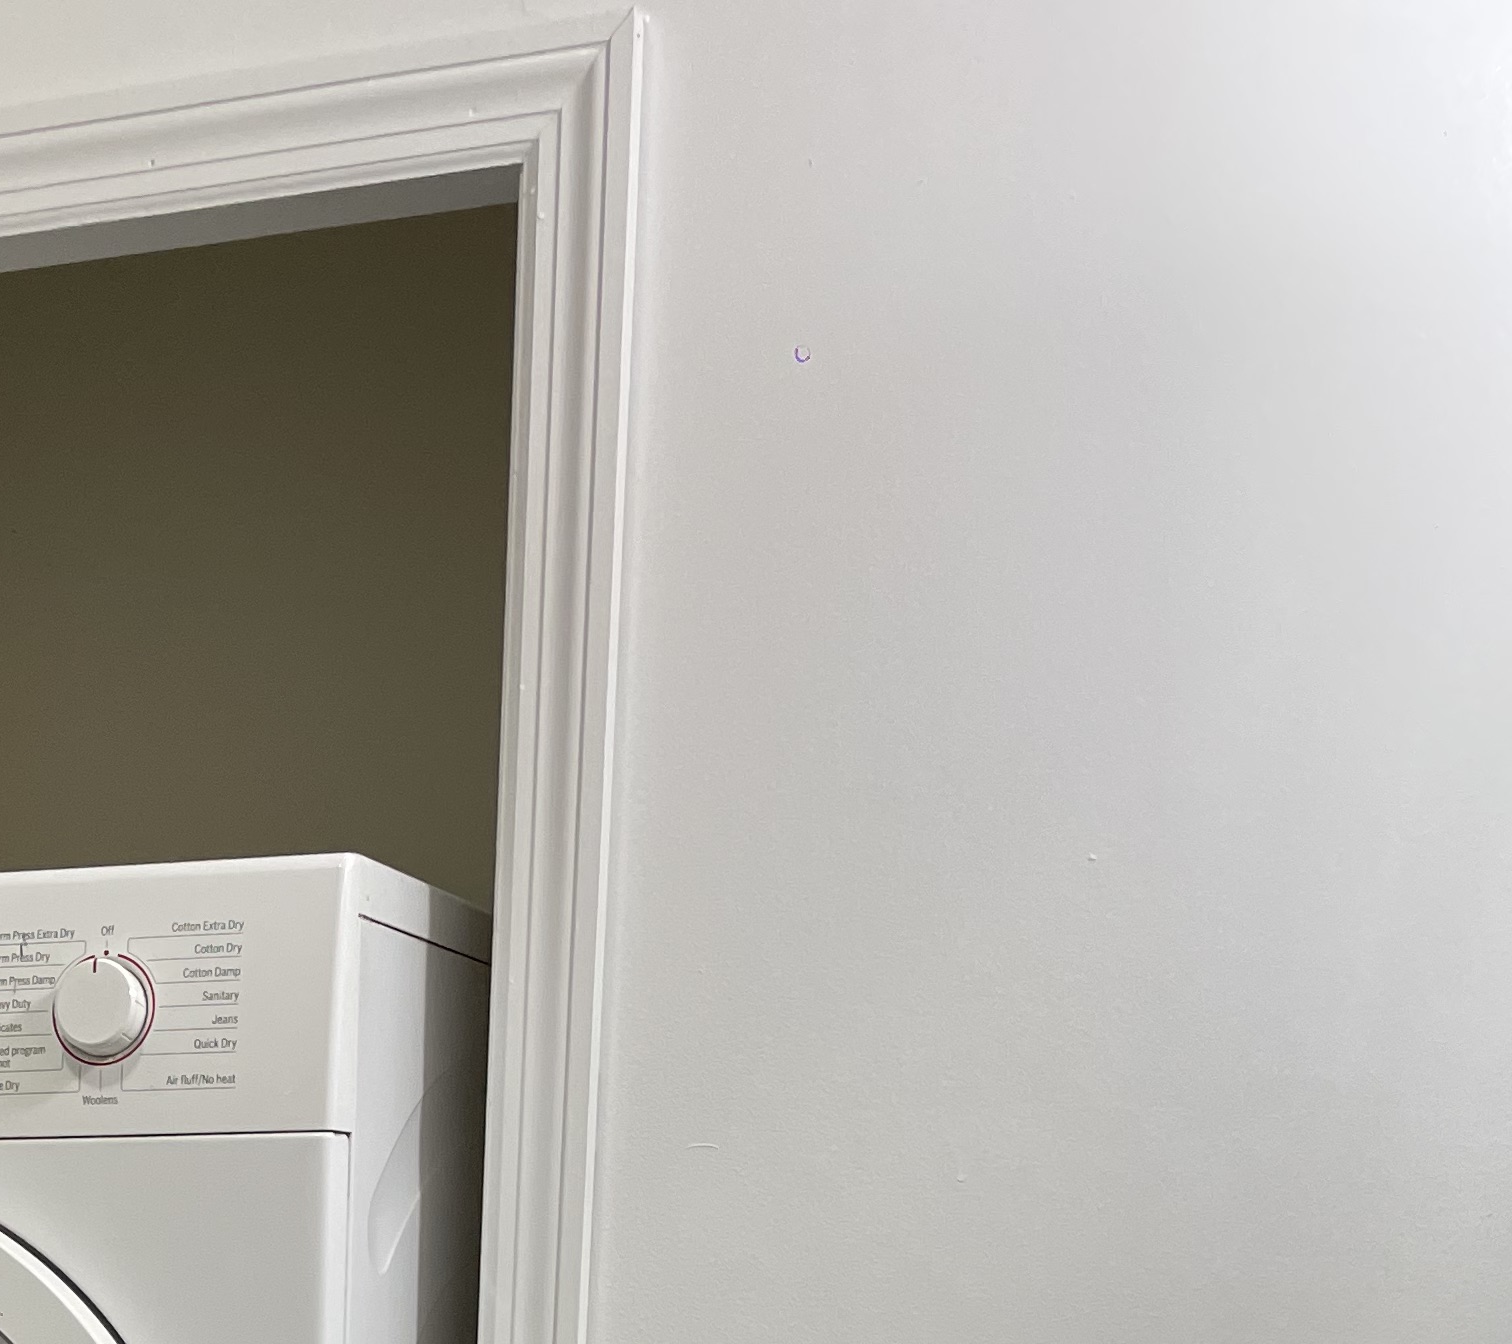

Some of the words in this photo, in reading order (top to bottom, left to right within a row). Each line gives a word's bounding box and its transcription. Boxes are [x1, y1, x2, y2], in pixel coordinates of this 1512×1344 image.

[101, 925, 114, 936] Off
[172, 922, 201, 932] Cotton
[203, 921, 226, 931] Extra
[229, 920, 244, 932] Dry
[37, 929, 58, 939] Extra
[60, 928, 75, 940] Dry
[194, 944, 224, 954] Cotton
[226, 943, 242, 954] Dry
[35, 952, 50, 963] Dry
[183, 967, 212, 978] Cotton
[215, 967, 241, 978] Damp
[9, 976, 30, 985] Press
[32, 975, 55, 985] Damp
[202, 991, 239, 1002] Sanitary
[12, 999, 31, 1010] Duty
[212, 1015, 238, 1024] Jeans
[194, 1039, 219, 1049] Quick
[221, 1038, 237, 1050] Dry
[11, 1046, 46, 1057] program
[166, 1076, 178, 1085] Air
[216, 1074, 236, 1084] heat
[5, 1080, 20, 1092] Dry
[83, 1095, 118, 1105] Woolens
